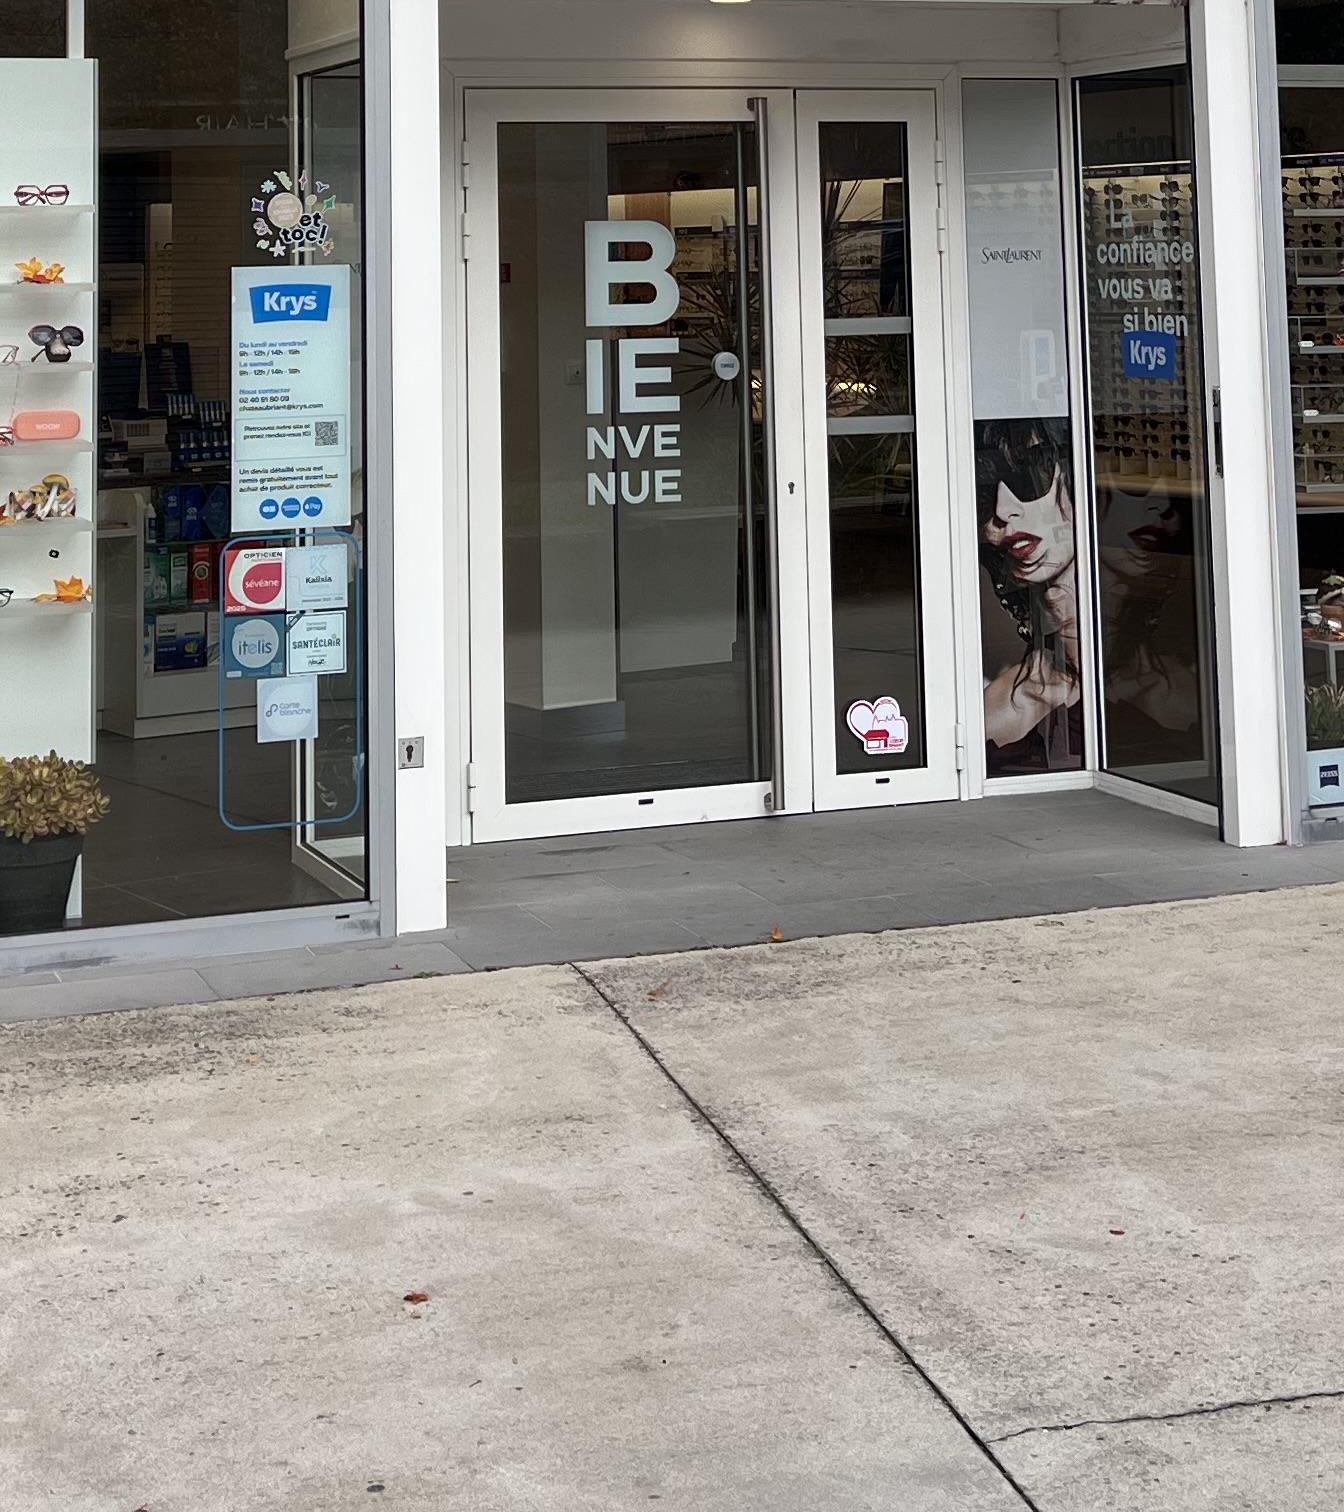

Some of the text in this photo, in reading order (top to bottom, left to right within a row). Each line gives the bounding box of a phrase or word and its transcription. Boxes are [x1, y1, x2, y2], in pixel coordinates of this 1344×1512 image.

[299, 212, 322, 227] et
[1109, 200, 1133, 228] La
[281, 225, 328, 245] toc!
[1096, 235, 1195, 265] confiance
[584, 220, 680, 327] B
[263, 291, 317, 315] Krys
[1098, 277, 1174, 300] vous va
[1123, 307, 1188, 336] si bien
[1129, 339, 1166, 371] Krys
[585, 337, 681, 415] IE
[587, 424, 681, 460] NVE
[587, 469, 682, 506] NUE
[238, 640, 272, 655] itelis
